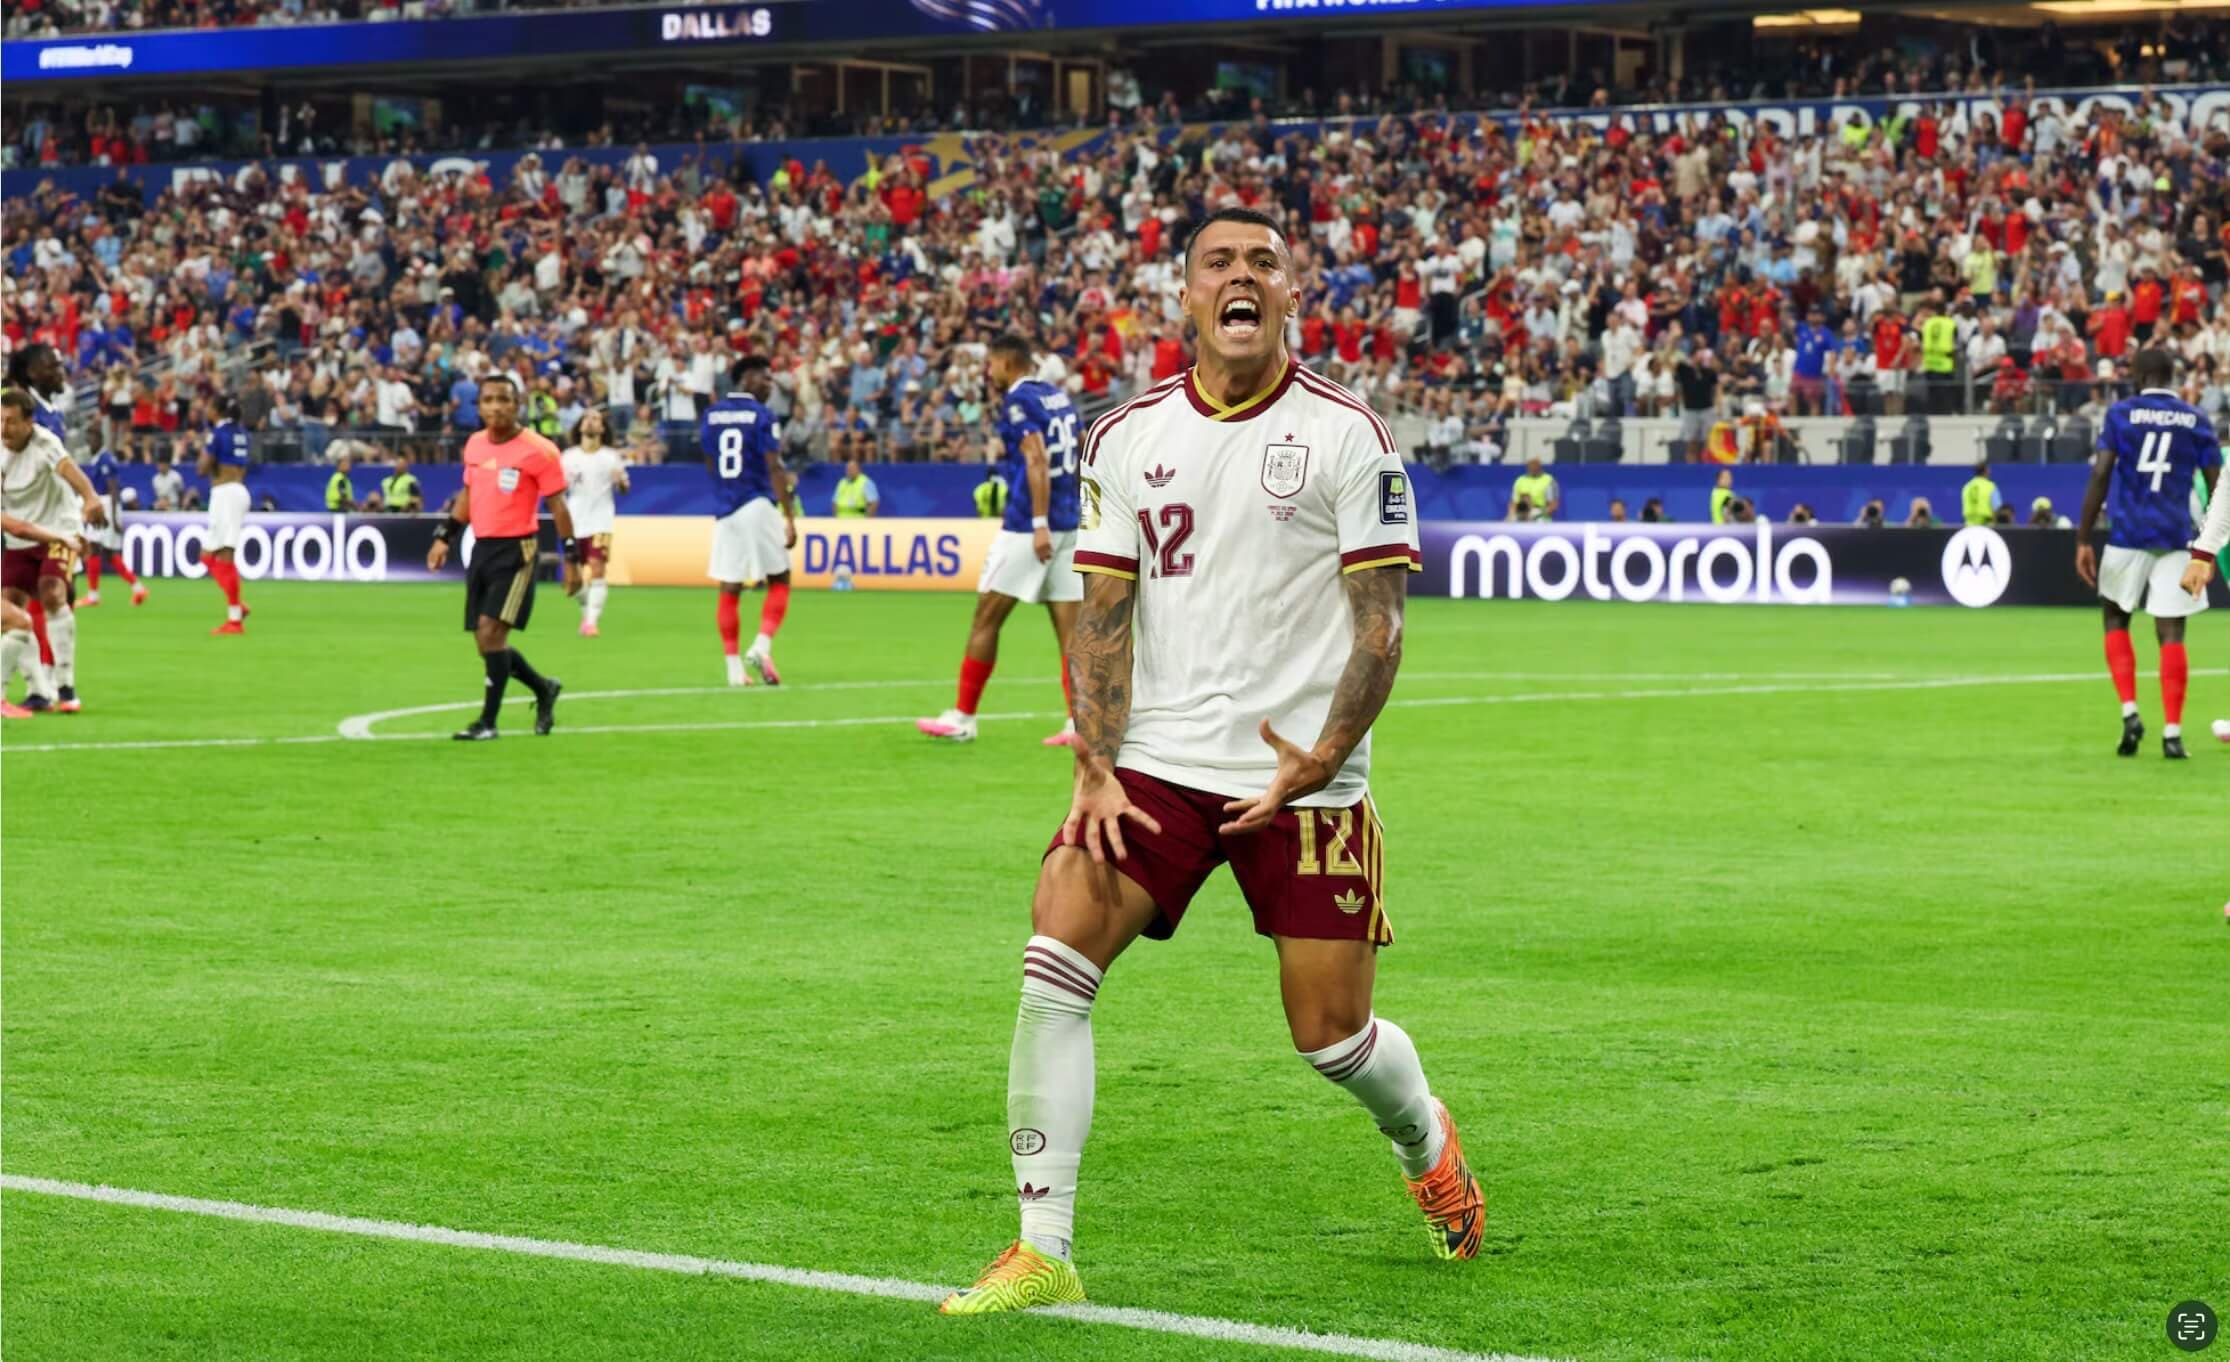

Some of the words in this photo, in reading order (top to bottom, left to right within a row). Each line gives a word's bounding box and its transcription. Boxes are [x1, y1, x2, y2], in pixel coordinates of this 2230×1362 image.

[662, 8, 771, 40] DALLAS
[719, 428, 743, 478] 8
[1047, 413, 1078, 478] 26
[2136, 432, 2172, 492] 4
[123, 513, 388, 580] moorola
[804, 533, 961, 577] DALLAS
[1137, 503, 1194, 579] 12
[1450, 523, 1832, 604] motorola
[1294, 806, 1363, 876] 12
